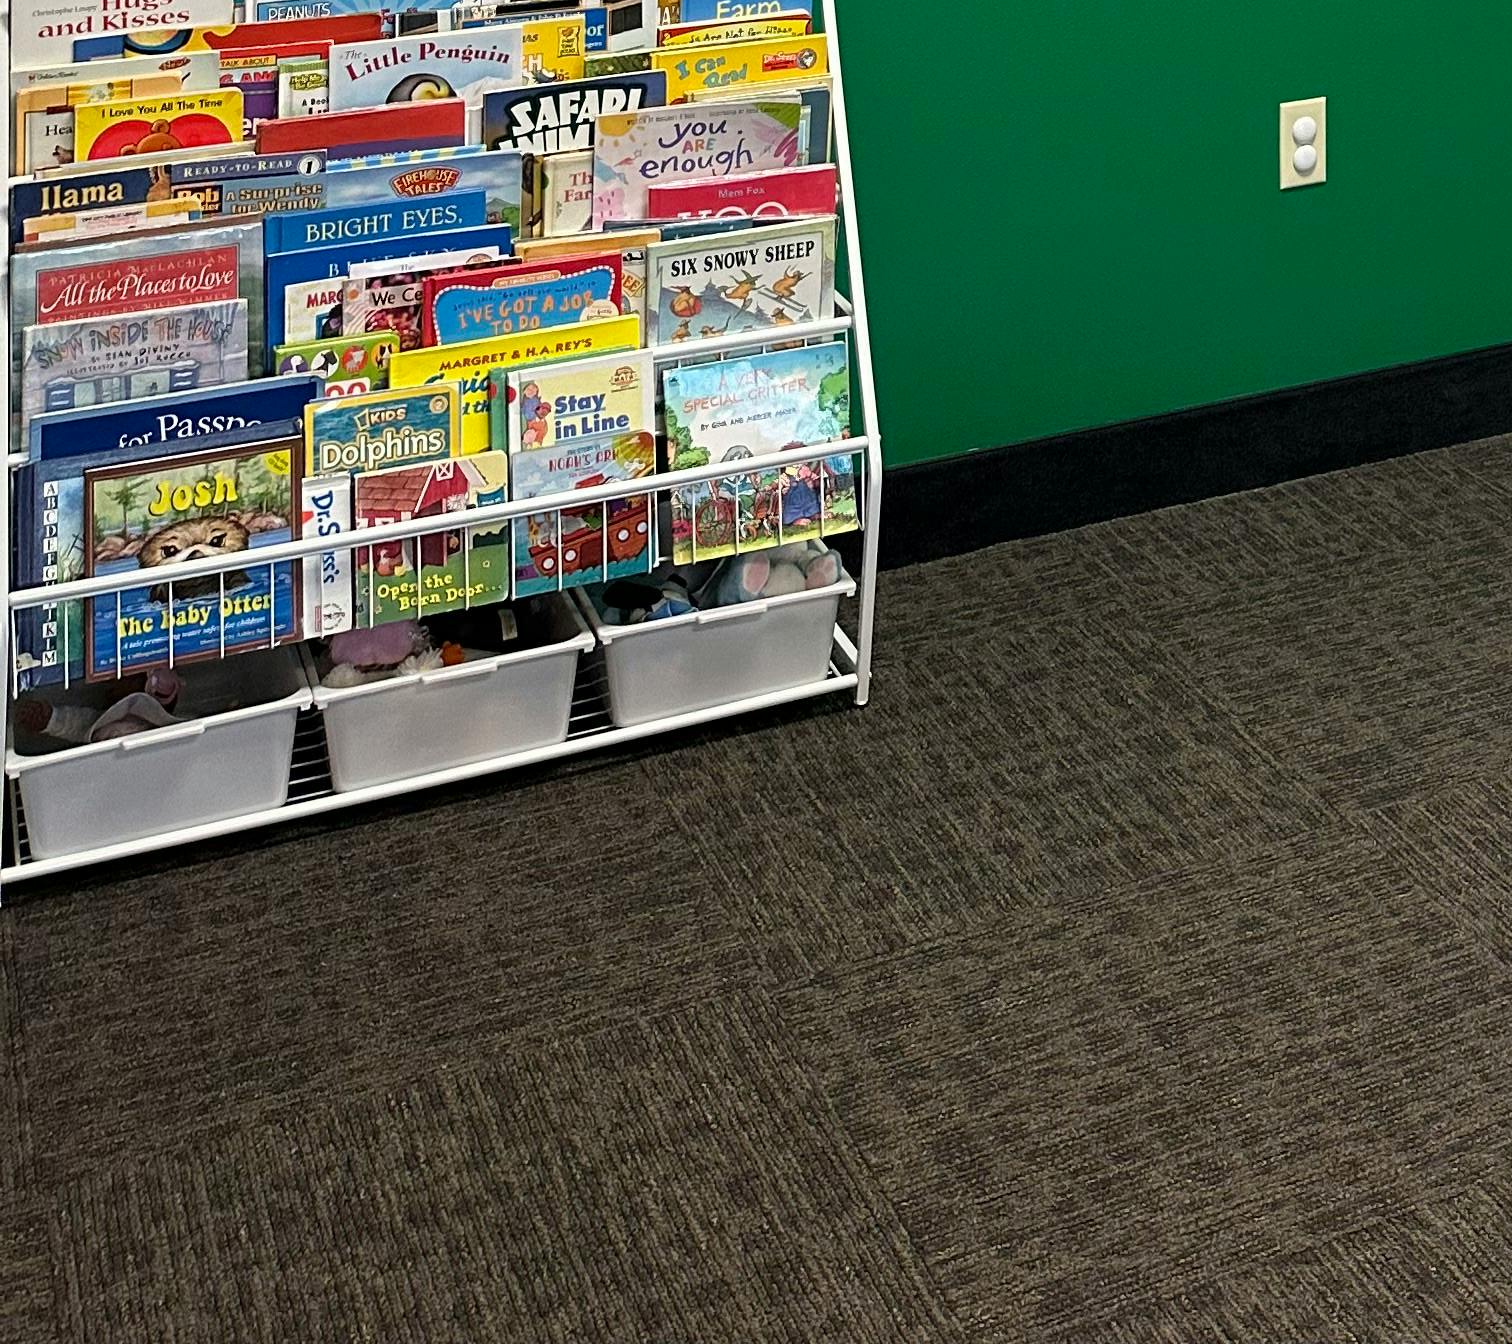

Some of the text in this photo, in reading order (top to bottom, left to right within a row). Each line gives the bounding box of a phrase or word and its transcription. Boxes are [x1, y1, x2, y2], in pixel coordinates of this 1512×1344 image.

[268, 2, 331, 21] PEANUTS
[717, 0, 781, 19] Farm
[38, 10, 190, 39] and Kisses
[345, 41, 511, 81] Little Penguin
[695, 56, 726, 73] Can
[703, 64, 747, 88] Read
[109, 106, 134, 117] Love
[137, 105, 157, 114] You
[160, 102, 173, 111] All
[178, 100, 195, 111] The
[199, 98, 222, 108] Time
[511, 88, 642, 136] SAFARI
[658, 119, 727, 149] you
[683, 138, 716, 154] ARE
[639, 138, 753, 179] enough
[41, 182, 124, 211] llama
[718, 186, 765, 198] Mem Fox
[306, 214, 392, 243] BRIGHT
[671, 240, 815, 277] SIX SNOWY SHEEP
[41, 282, 84, 313] All
[89, 279, 116, 303] the
[117, 273, 176, 300] Places
[179, 273, 196, 288] to
[192, 264, 234, 292] Love
[372, 292, 396, 306] We
[554, 393, 605, 414] Stay
[683, 377, 810, 413] SPECIAL CRITTER
[370, 408, 406, 424] KIDS
[555, 414, 629, 440] in Line
[119, 431, 153, 448] for
[321, 428, 444, 470] Dolphins
[149, 472, 239, 516] Josh
[425, 574, 452, 589] the
[219, 593, 271, 617] Otter
